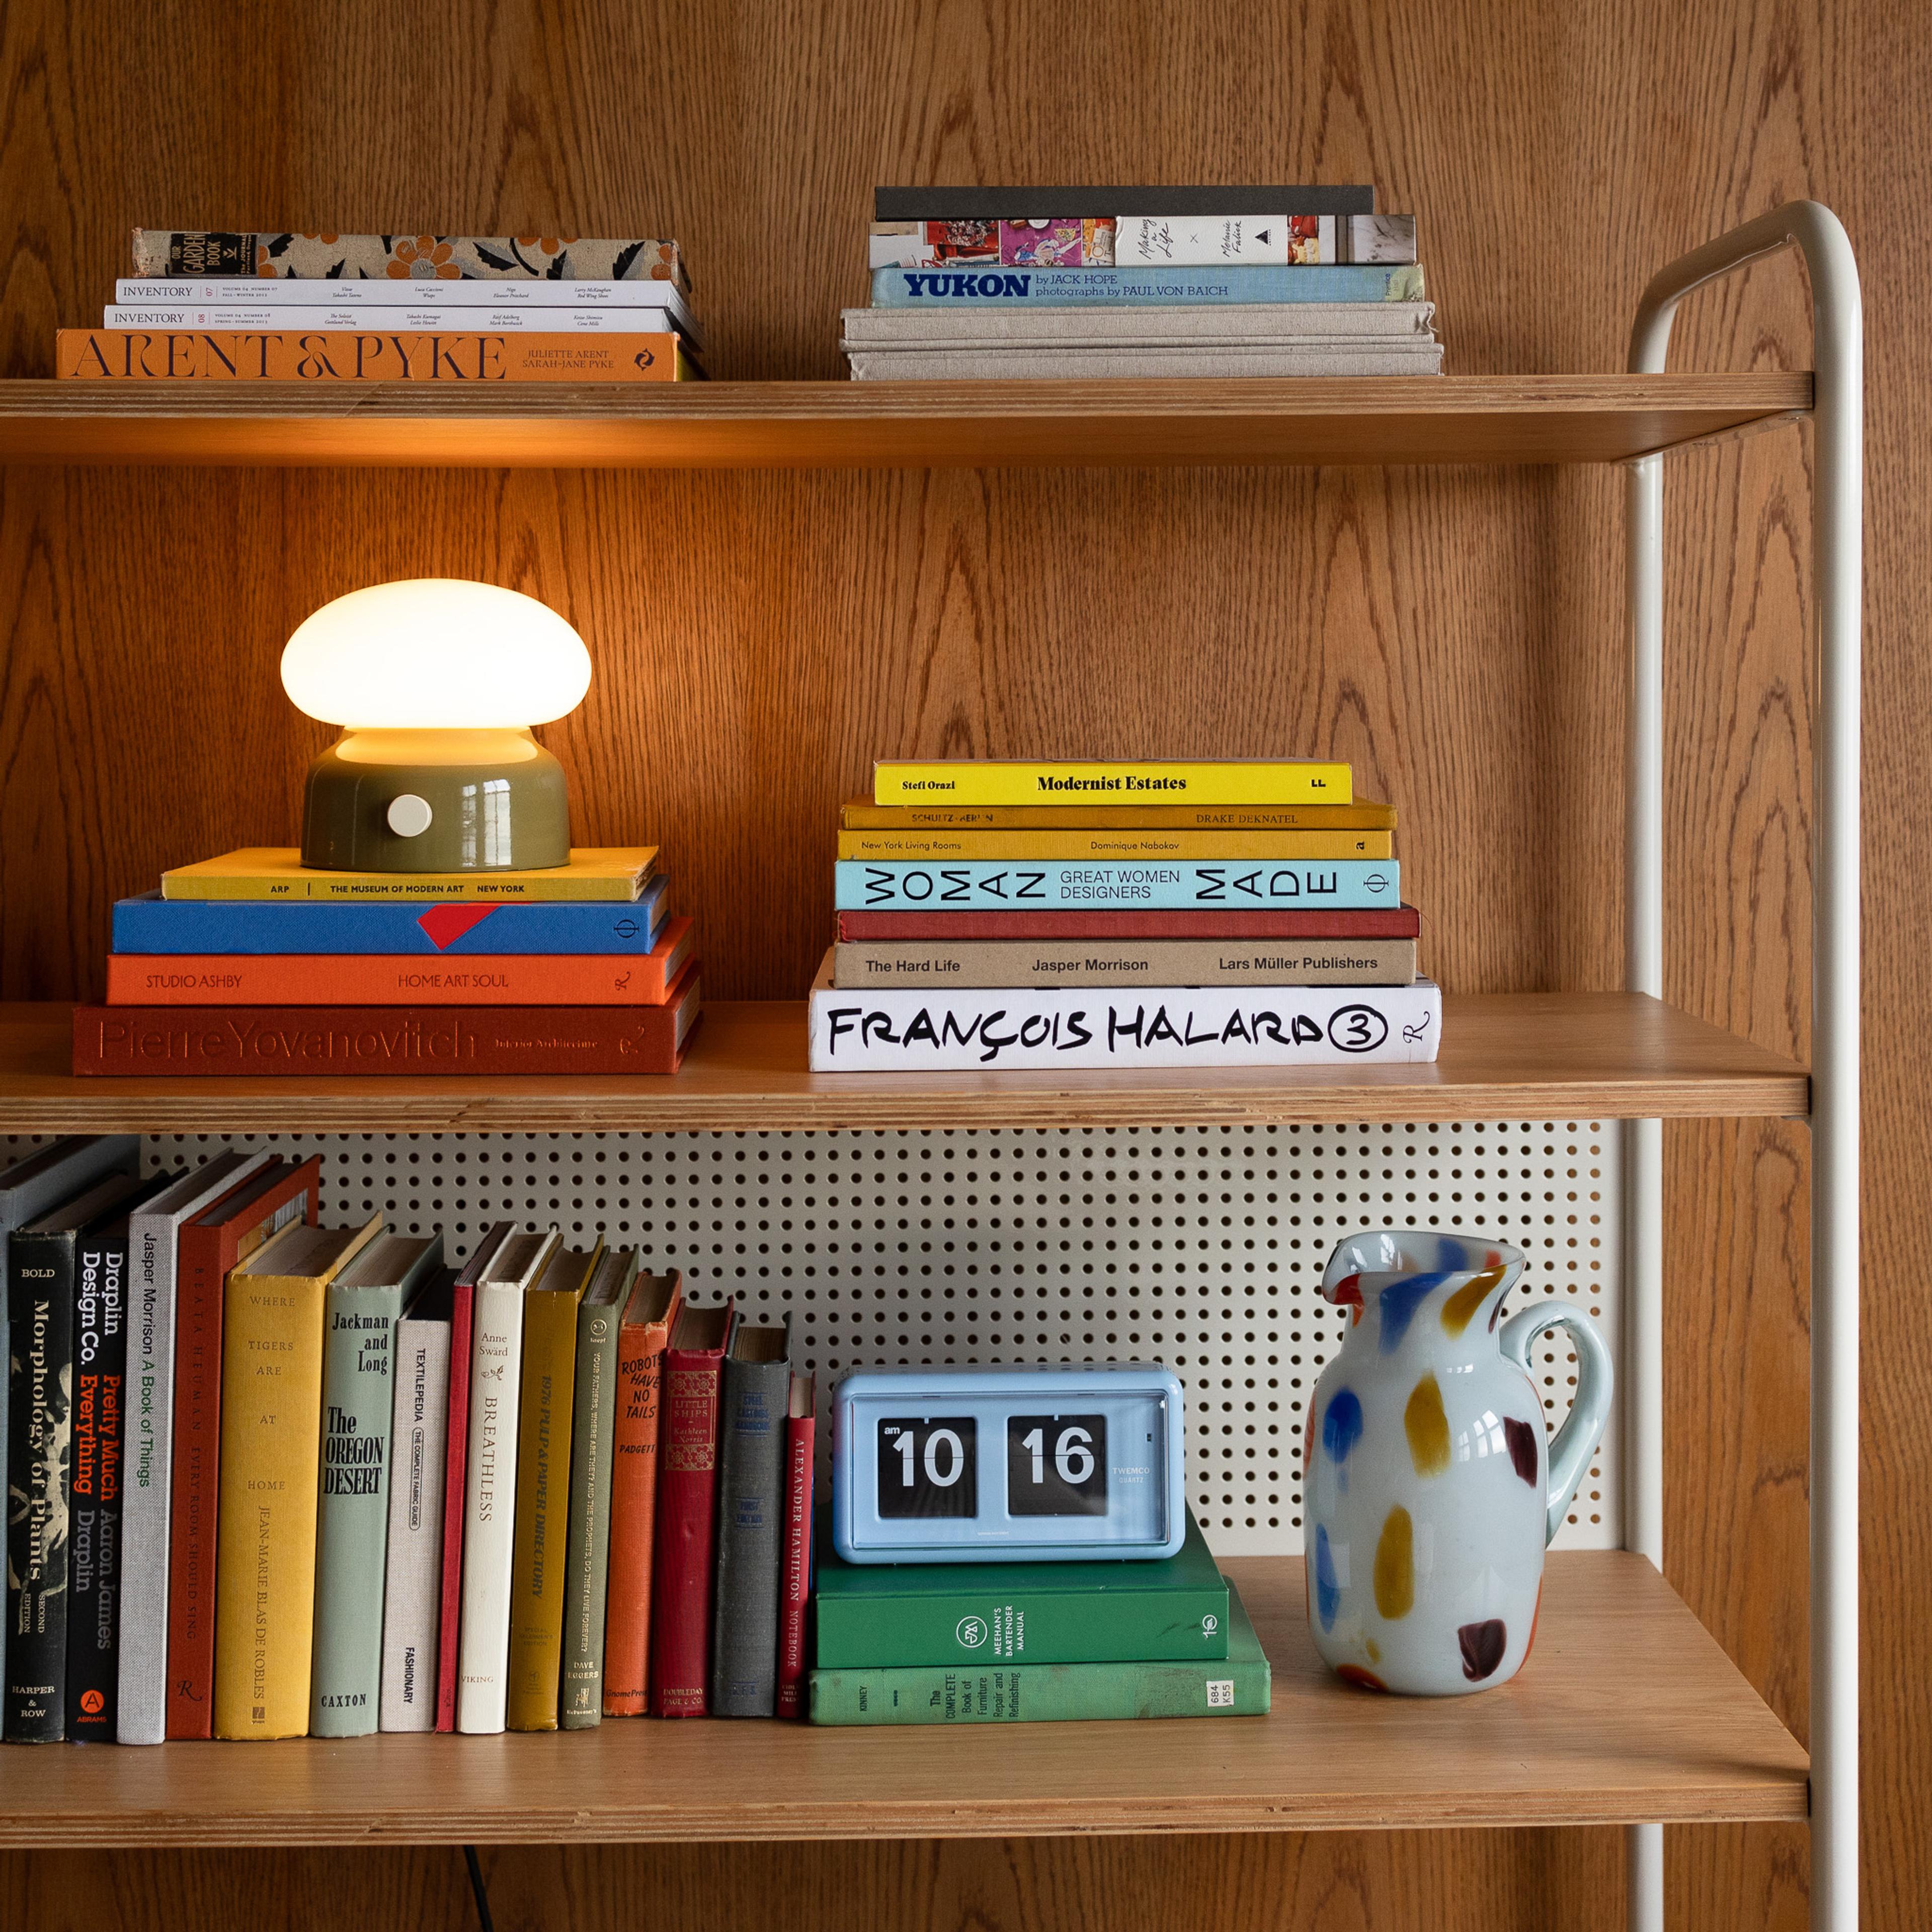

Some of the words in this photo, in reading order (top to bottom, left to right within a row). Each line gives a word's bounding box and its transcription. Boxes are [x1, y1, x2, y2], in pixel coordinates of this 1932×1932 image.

[1139, 218, 1157, 260] Making
[1157, 222, 1174, 258] Life
[1220, 219, 1232, 258] Melanie
[172, 246, 181, 259] OUR
[183, 233, 206, 274] GARDEN
[207, 241, 221, 267] BOOK
[904, 274, 1031, 297] YUKON
[1036, 275, 1047, 285] by
[1050, 275, 1080, 284] JACK
[1084, 275, 1117, 284] HOPE
[124, 287, 193, 296] INVENTORY
[205, 287, 213, 296] 07
[1036, 287, 1104, 298] photographs
[1107, 287, 1120, 297] by
[1123, 286, 1154, 295] PAUL
[1156, 286, 1184, 295] VON
[1187, 286, 1228, 295] BAICH
[115, 313, 185, 323] INVENTORY
[198, 313, 205, 323] 08
[70, 334, 283, 378] ARENT
[297, 335, 341, 378] &
[353, 336, 506, 379] PYKE
[528, 350, 573, 359] JULIETTE
[575, 350, 609, 358] ARENT
[522, 360, 586, 369] SARAH-JANE
[589, 360, 614, 368] PYKE
[902, 781, 926, 789] Stefi
[928, 781, 955, 789] Orazi
[1037, 776, 1121, 790] Modernist
[1125, 776, 1186, 790] Estates
[1196, 814, 1235, 823] DRAKE
[1239, 814, 1298, 824] DEKNATEL
[861, 841, 881, 850] New
[883, 841, 903, 850] York
[905, 841, 931, 852] Living
[933, 841, 961, 850] Rooms
[1091, 841, 1138, 851] Dominique
[1140, 841, 1179, 850] Nabokov
[865, 867, 1046, 905] WOMAN
[1195, 868, 1337, 900] MADE
[1060, 870, 1113, 883] GREAT
[1117, 870, 1180, 882] WOMEN
[271, 885, 289, 894] ARP
[330, 885, 348, 894] THE
[351, 885, 388, 894] MUSEUM
[391, 885, 403, 894] OF
[406, 884, 444, 893] MODERN
[447, 884, 464, 893] ART
[477, 884, 499, 893] NEW
[501, 884, 524, 893] YORK
[1061, 886, 1151, 899] DESIGNERS
[866, 960, 892, 972] The
[896, 959, 931, 972] Hard
[935, 959, 960, 972] Life
[1032, 959, 1081, 974] Jasper
[1085, 959, 1149, 972] Morrison
[1220, 958, 1250, 970] Lars
[1254, 957, 1299, 970] Müller
[1303, 957, 1378, 970] Publishers
[146, 975, 196, 988] STUDIO
[198, 975, 242, 988] ASHBY
[398, 975, 442, 988] HOME
[444, 975, 470, 988] ART
[472, 975, 509, 988] SOUL
[100, 1020, 223, 1058] Pierre
[227, 1020, 475, 1058] Yovanovitch
[827, 1006, 1093, 1063] FRANÇOIS
[1108, 1004, 1324, 1053] HALARD
[143, 1233, 157, 1287] Jasper
[21, 1268, 55, 1277] BOLD
[78, 1252, 100, 1328] Design
[104, 1253, 124, 1335] Draplin
[250, 1296, 296, 1307] WHERE
[142, 1289, 156, 1355] Morrison
[332, 1312, 389, 1331] Jackman
[248, 1340, 294, 1350] TIGERS
[364, 1334, 388, 1350] and
[481, 1332, 507, 1343] Anne
[80, 1332, 99, 1365] Co.
[479, 1346, 508, 1356] Swärd
[142, 1359, 154, 1372] A
[256, 1366, 282, 1376] ARE
[358, 1350, 387, 1376] Long
[28, 1300, 49, 1454] Morphology
[414, 1348, 426, 1422] TEXTILEPEDIA
[140, 1376, 154, 1414] Book
[591, 1375, 600, 1410] FATHERS,
[98, 1375, 121, 1433] Pretty
[140, 1418, 152, 1433] of
[260, 1415, 276, 1424] AT
[328, 1406, 357, 1433] The
[73, 1375, 98, 1495] Everything
[884, 1427, 901, 1435] am
[326, 1437, 385, 1465] OREGON
[479, 1397, 498, 1521] BREATHLESS
[893, 1428, 964, 1487] 10
[1022, 1426, 1095, 1484] 16
[100, 1437, 120, 1501] Much
[137, 1438, 153, 1487] Things
[588, 1457, 596, 1481] THEY?
[31, 1461, 45, 1491] of
[248, 1480, 285, 1490] HOME
[324, 1467, 382, 1495] DESERT
[792, 1439, 805, 1522] ALEXANDER
[30, 1499, 46, 1580] Plants
[584, 1517, 593, 1559] PROPHETS,
[584, 1560, 591, 1572] DO
[790, 1528, 801, 1601] HAMILTON
[581, 1613, 589, 1652] FOREVER?
[787, 1611, 800, 1667] NOTEBOOK
[404, 1647, 415, 1703] FASHIONARY
[568, 1671, 599, 1679] EGGERS
[961, 1680, 972, 1689] of
[993, 1672, 1003, 1689] and
[12, 1685, 55, 1695] HARPER
[930, 1690, 941, 1707] The
[945, 1673, 956, 1719] COMPLETE
[978, 1677, 987, 1715] Furniture
[1009, 1672, 1020, 1718] Refinishing
[1223, 1684, 1231, 1703] K55
[321, 1694, 367, 1707] CAXTON
[961, 1693, 972, 1713] Book
[993, 1693, 1005, 1718] Repair
[21, 1709, 46, 1717] ROW
